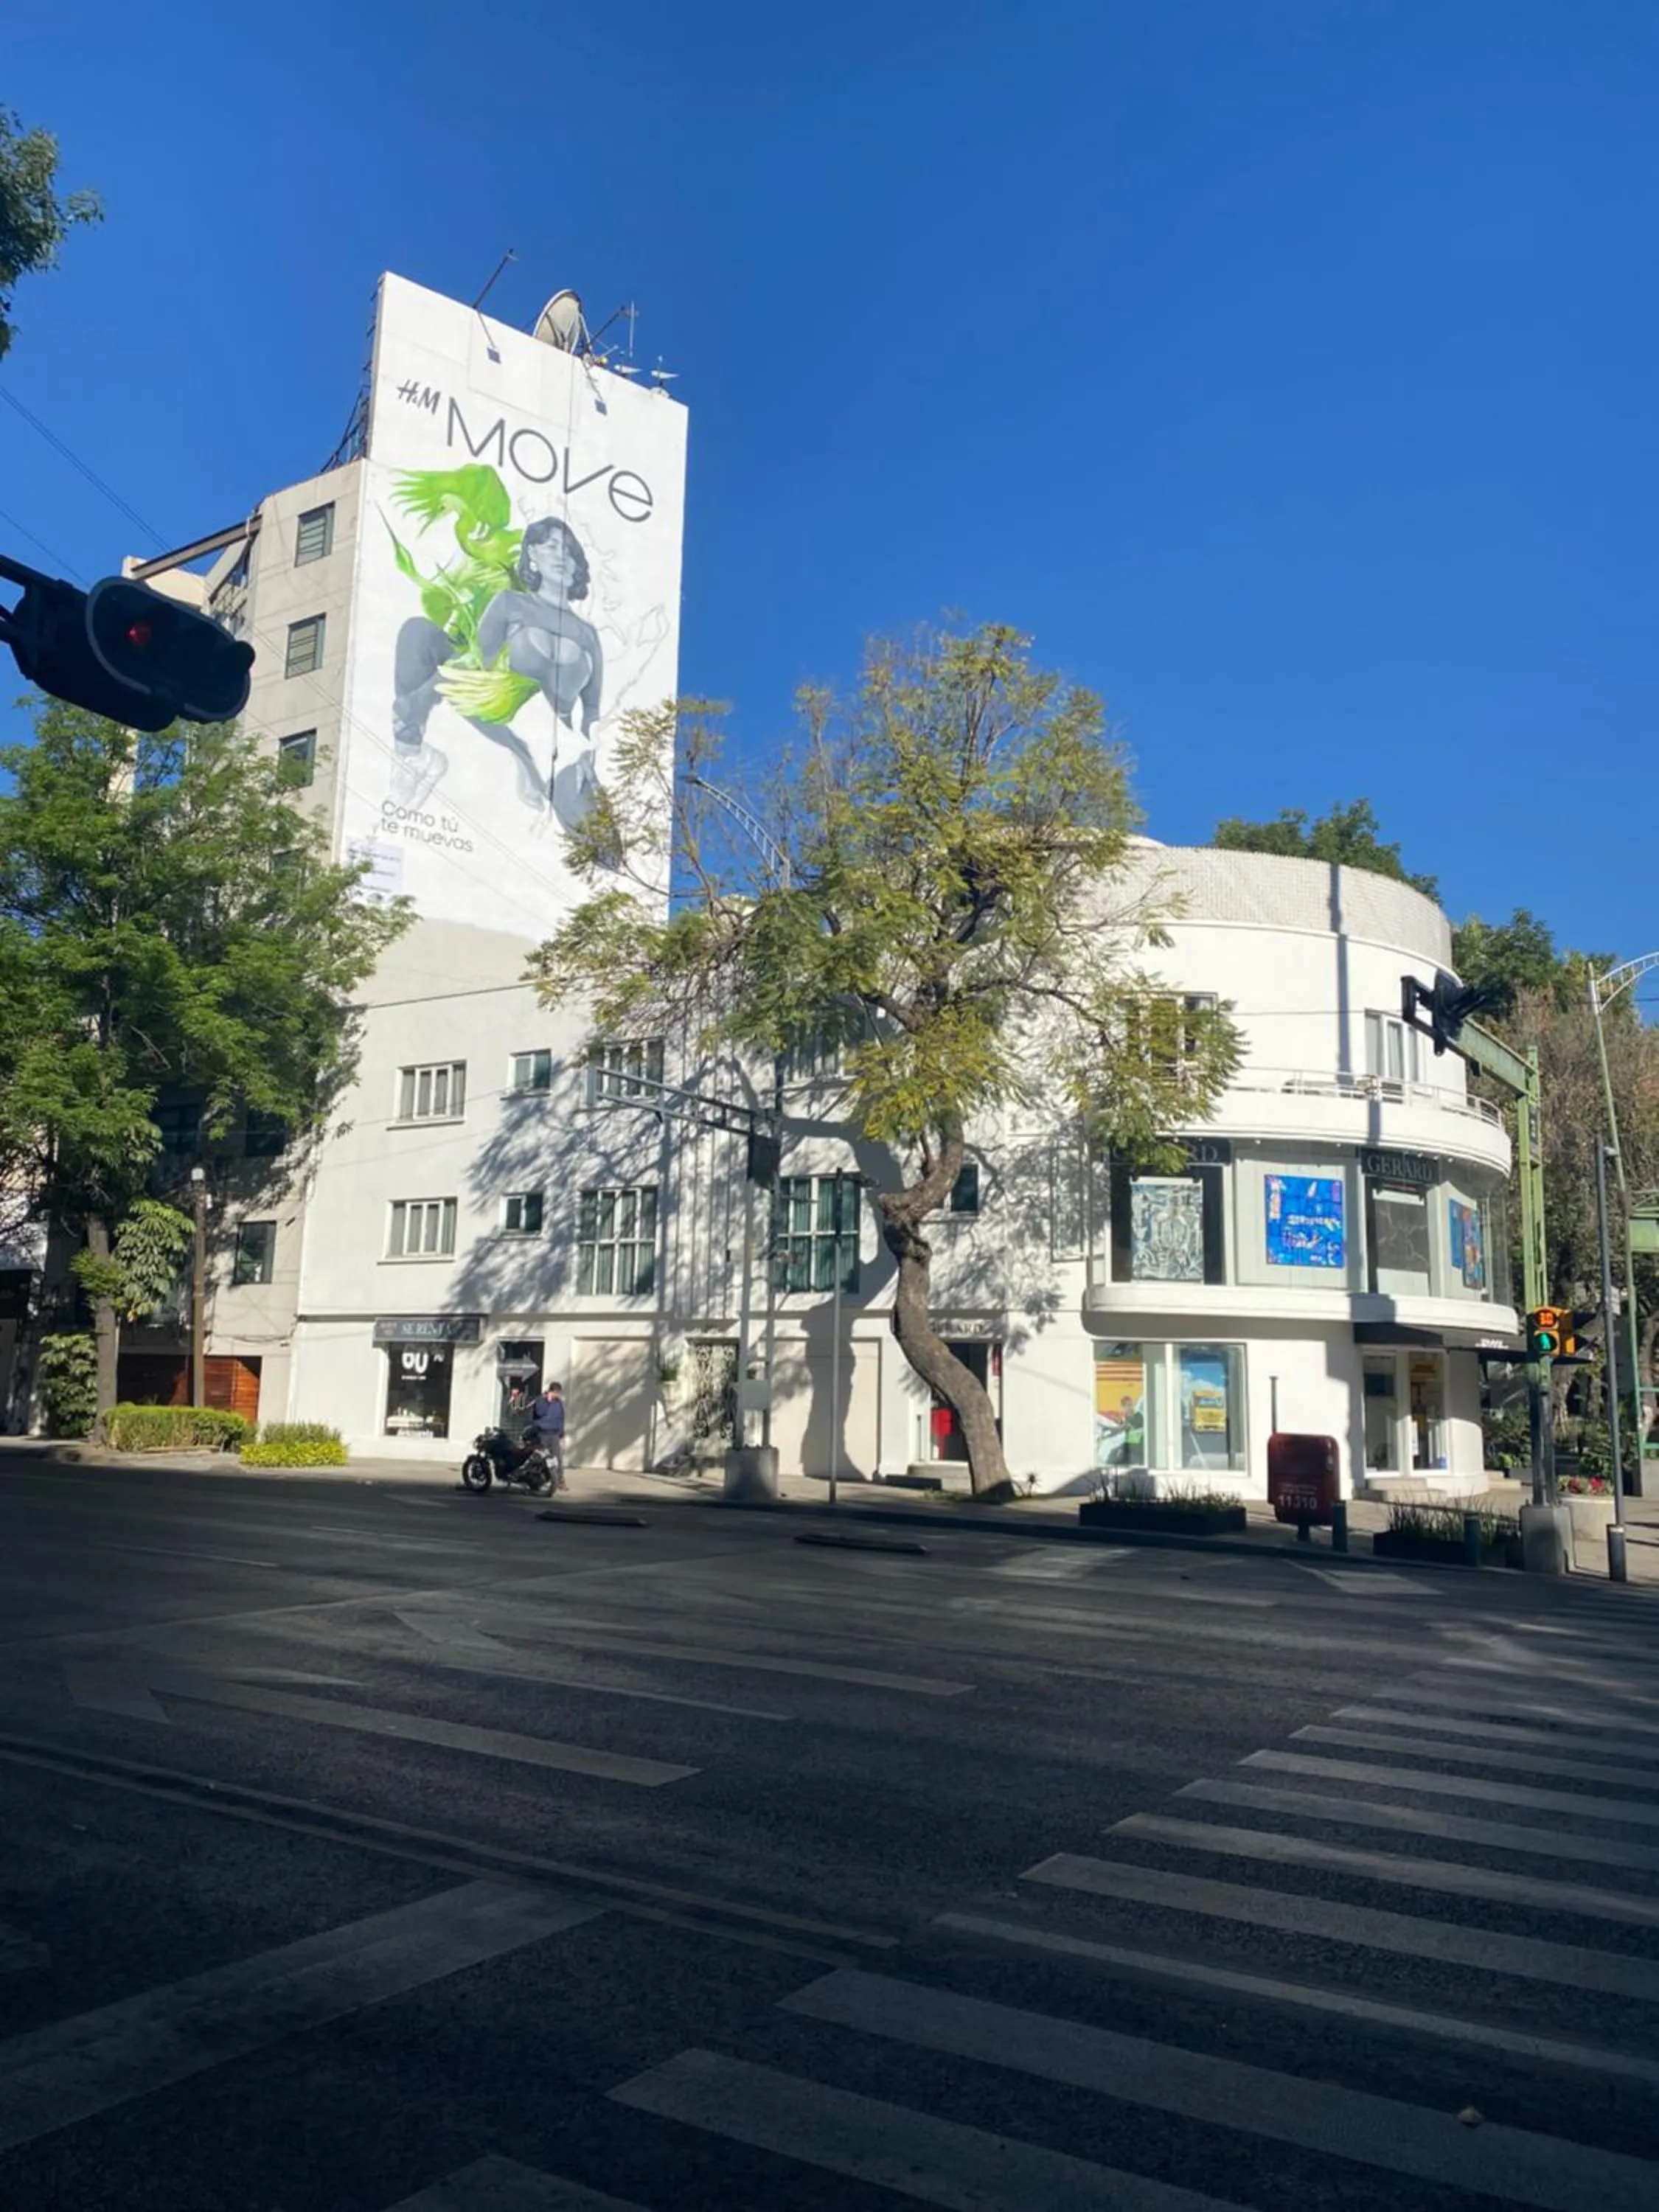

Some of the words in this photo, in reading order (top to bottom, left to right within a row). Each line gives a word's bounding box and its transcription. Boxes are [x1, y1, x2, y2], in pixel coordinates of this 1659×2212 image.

[381, 817, 399, 834] te
[403, 824, 473, 852] muevas
[441, 816, 459, 833] tú
[1367, 1154, 1432, 1181] GERARD
